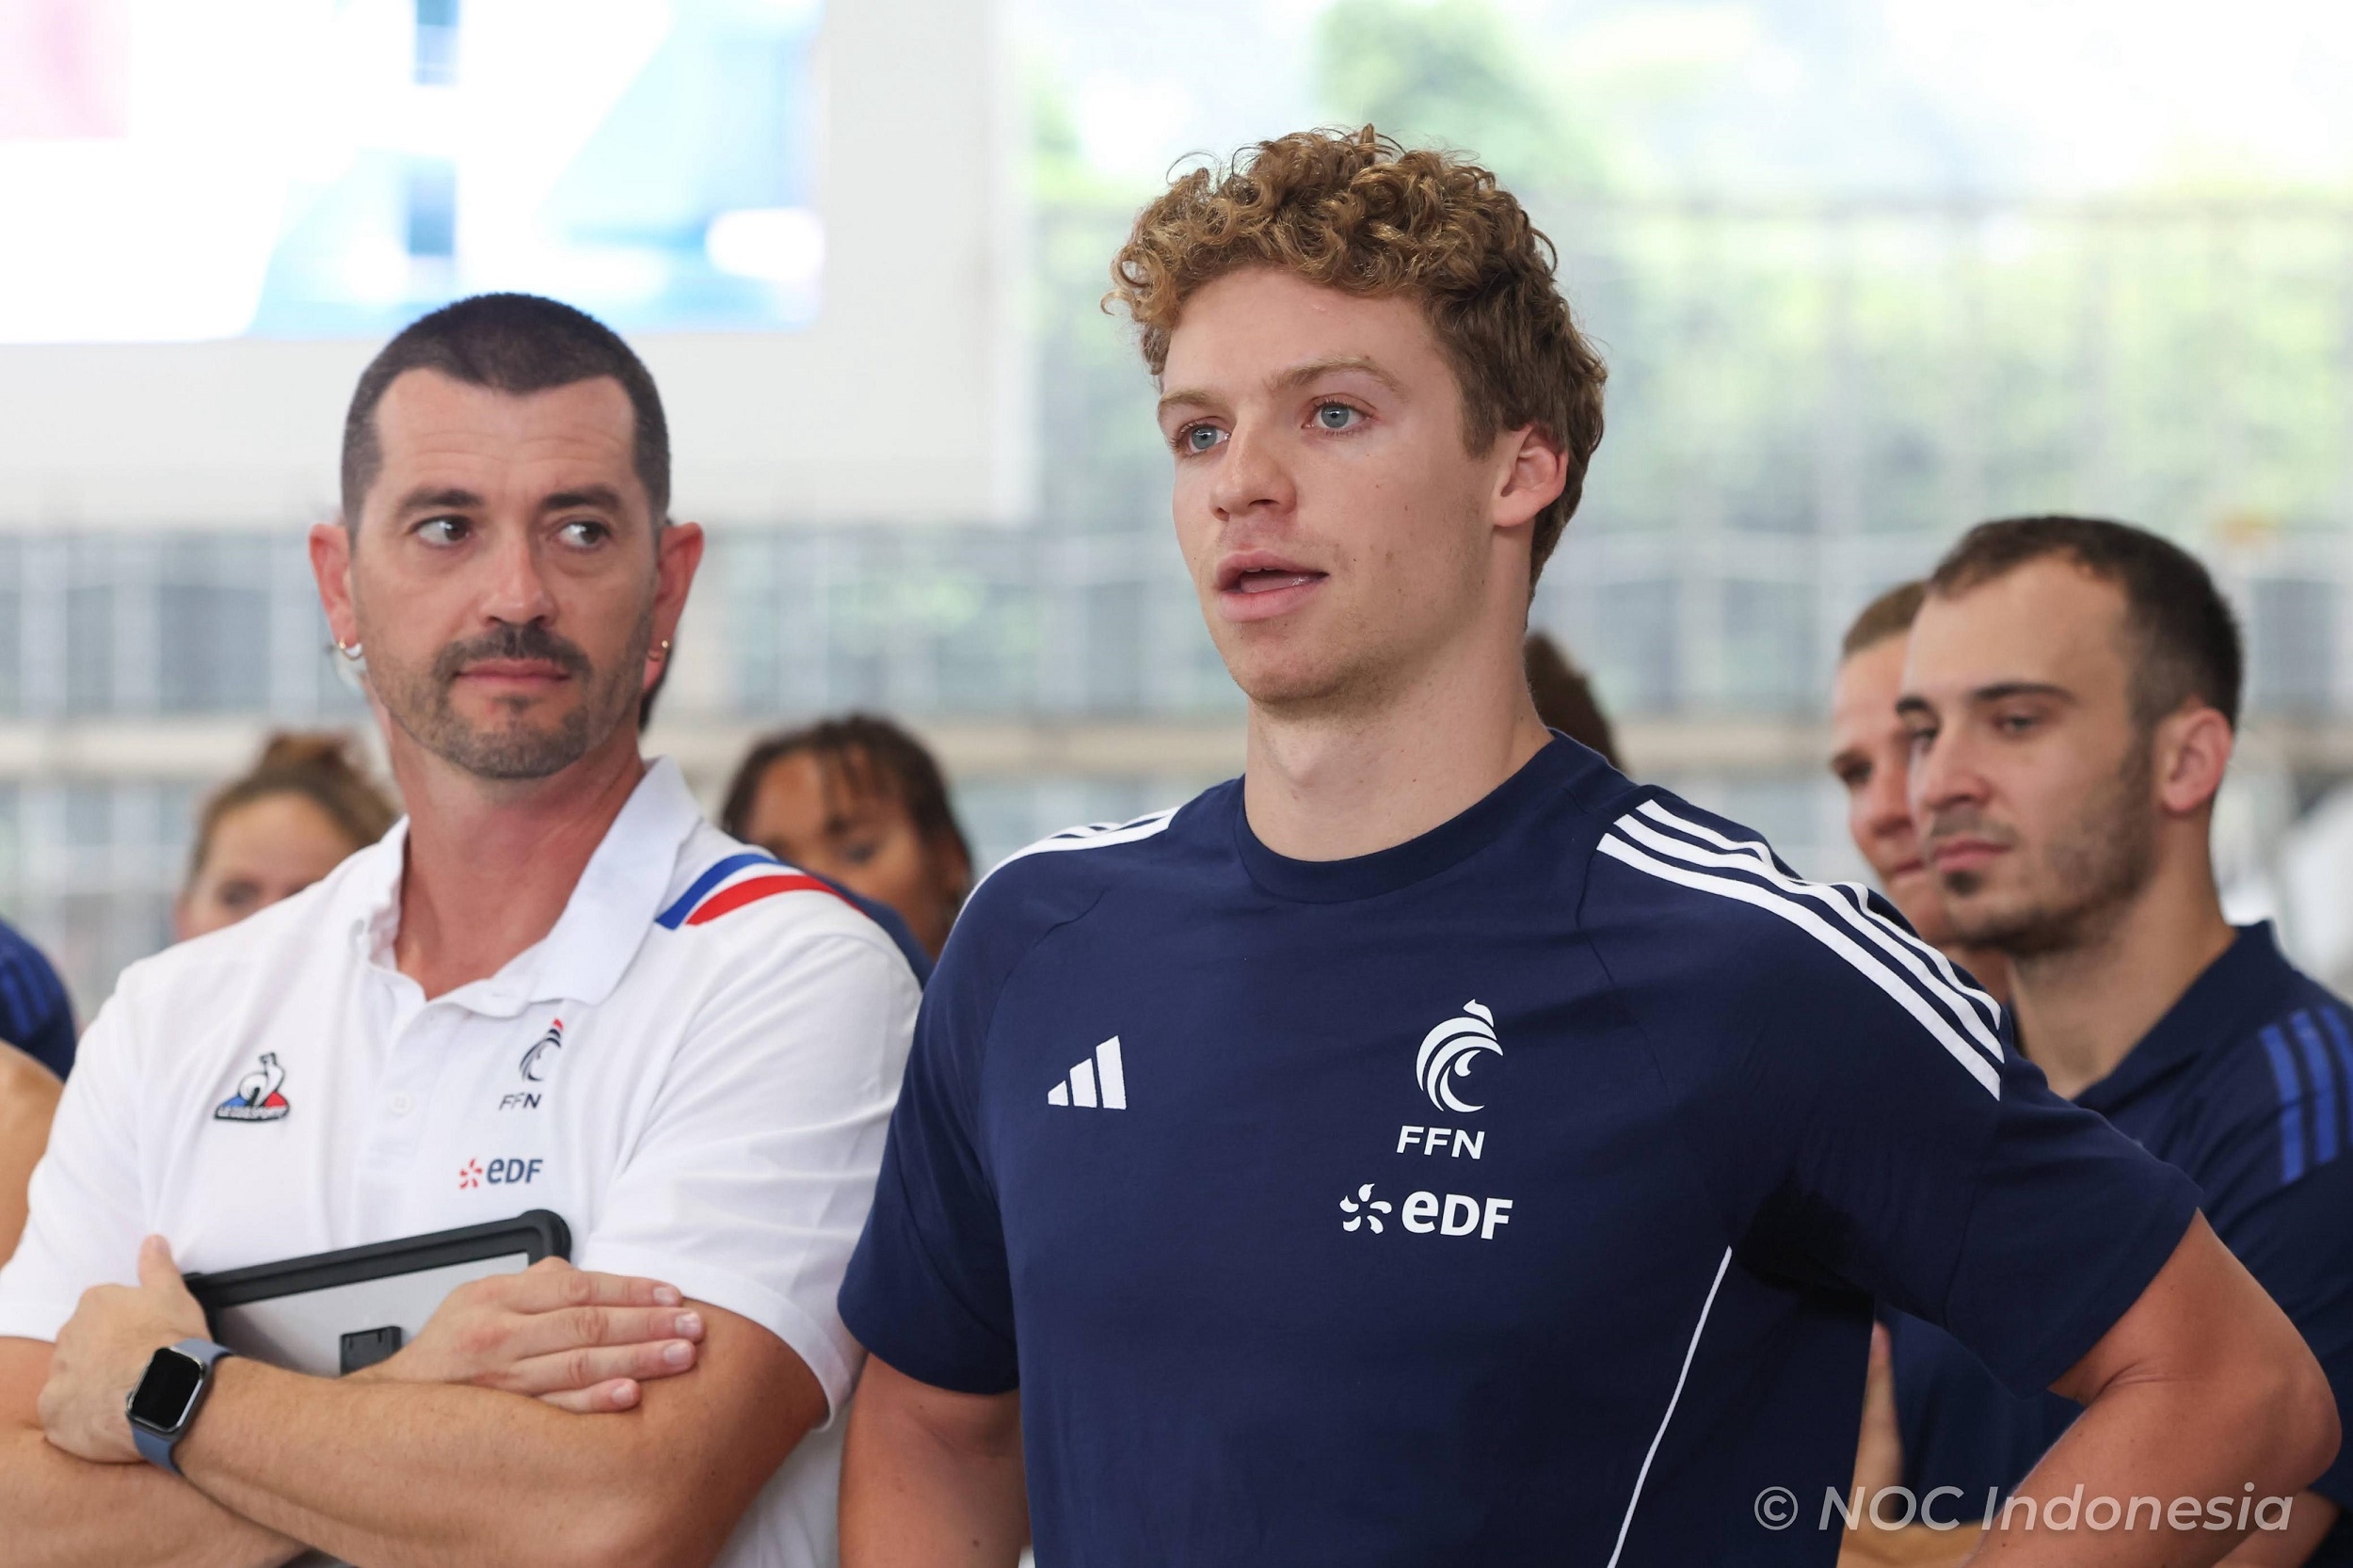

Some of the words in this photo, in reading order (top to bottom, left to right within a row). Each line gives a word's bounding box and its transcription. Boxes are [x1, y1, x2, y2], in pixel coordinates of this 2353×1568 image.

[498, 1093, 542, 1111] FFN
[1396, 1125, 1485, 1160] FFN
[487, 1159, 543, 1184] eDF
[1401, 1191, 1513, 1240] eDF
